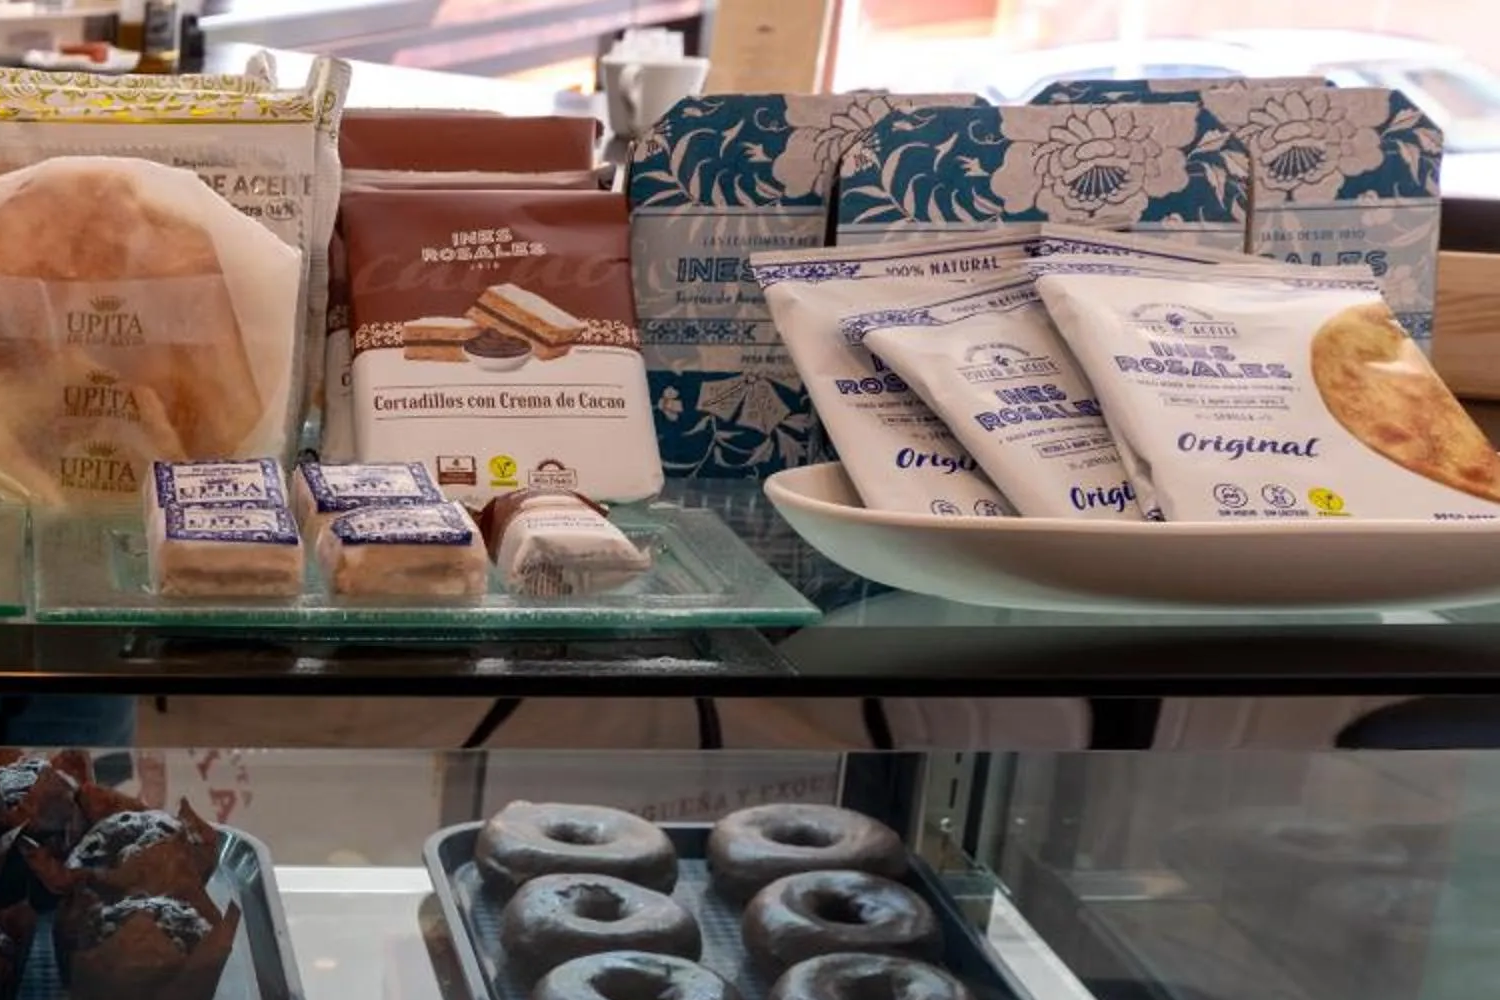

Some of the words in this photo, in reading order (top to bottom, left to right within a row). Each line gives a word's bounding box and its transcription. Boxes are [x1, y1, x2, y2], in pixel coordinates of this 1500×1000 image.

[451, 227, 512, 247] INES
[421, 241, 547, 262] ROSALES
[930, 255, 1000, 276] NATURAL
[67, 312, 143, 334] UPITA
[1114, 355, 1292, 379] ROSALES
[836, 373, 909, 395] ROS
[64, 386, 139, 410] UPITA
[374, 393, 463, 411] Cortadillos
[468, 396, 495, 409] con
[500, 393, 551, 409] Crema
[557, 392, 574, 408] de
[579, 393, 625, 409] Cacao
[974, 398, 1102, 432] ROSALE
[1177, 432, 1321, 461] Original
[60, 459, 135, 482] UPITA
[1070, 479, 1137, 513] Origi
